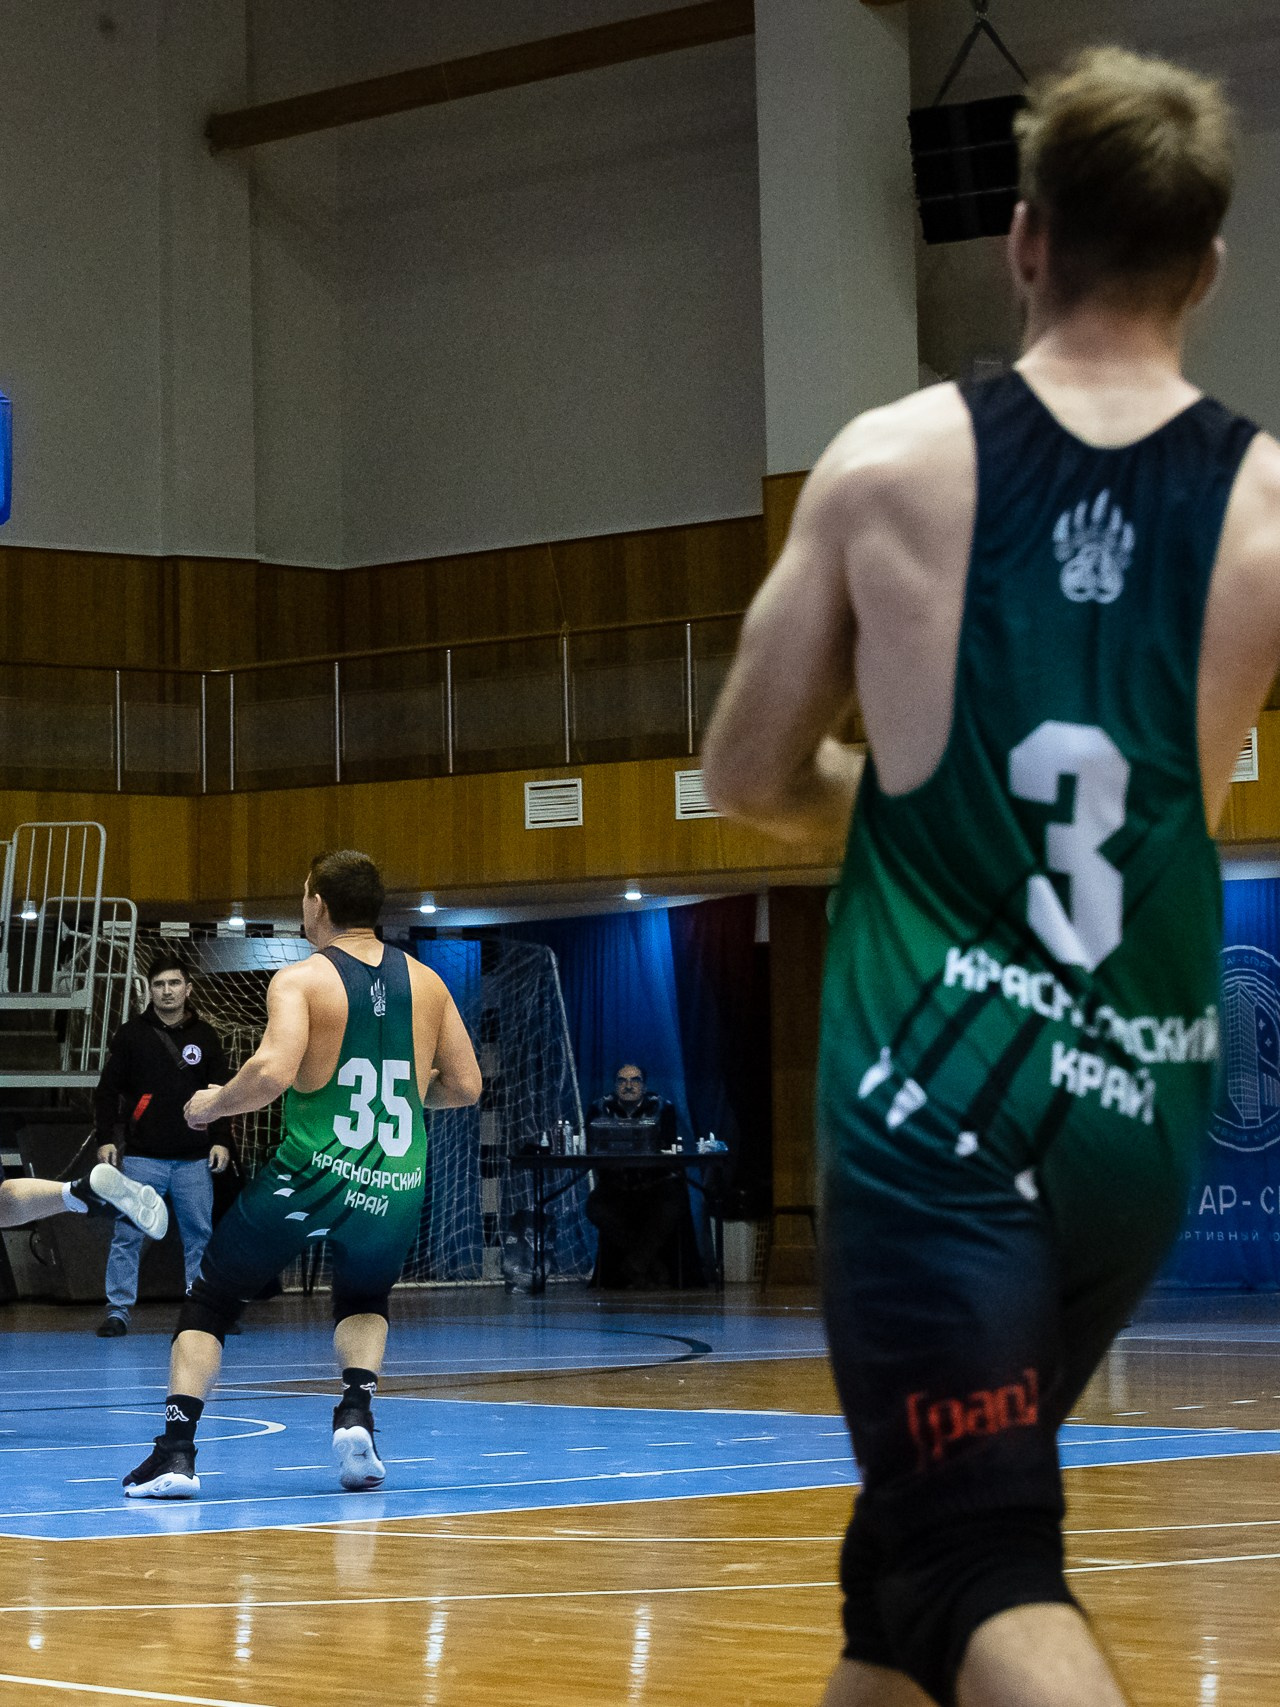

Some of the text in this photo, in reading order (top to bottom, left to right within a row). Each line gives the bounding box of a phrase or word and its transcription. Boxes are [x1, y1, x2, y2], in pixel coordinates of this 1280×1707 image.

[1007, 718, 1132, 974] 3
[942, 945, 1219, 1066] КРАСНСКИЙ
[332, 1057, 413, 1158] 35
[1050, 1039, 1157, 1126] КРАЙ
[311, 1150, 422, 1192] КРАСНОЯРСКИЙ
[343, 1189, 390, 1218] КРАЙ
